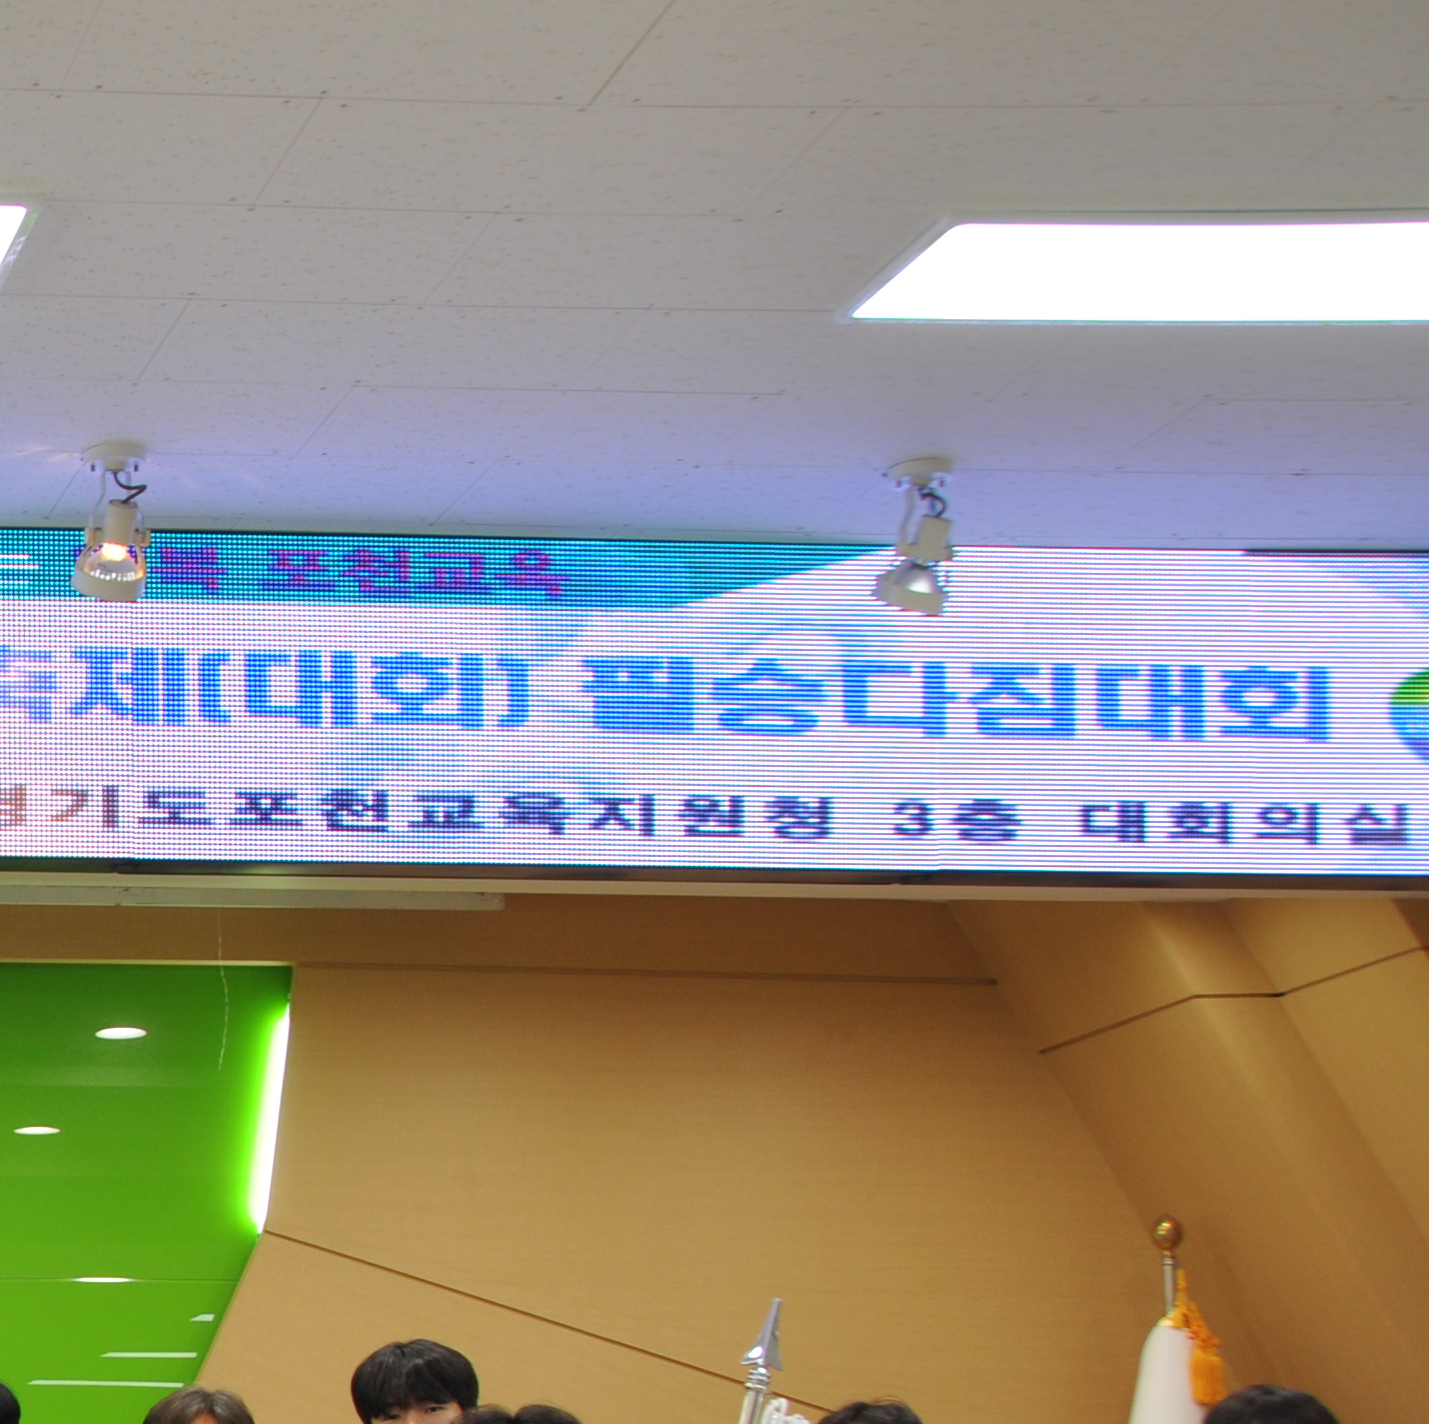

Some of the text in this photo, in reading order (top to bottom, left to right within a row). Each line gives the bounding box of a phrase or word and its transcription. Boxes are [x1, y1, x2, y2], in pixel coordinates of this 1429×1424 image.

[259, 546, 571, 600] 포천교육
[579, 655, 1331, 742] 필승다짐대회
[893, 797, 1022, 842] 3층
[1079, 799, 1410, 846] 대회의실
